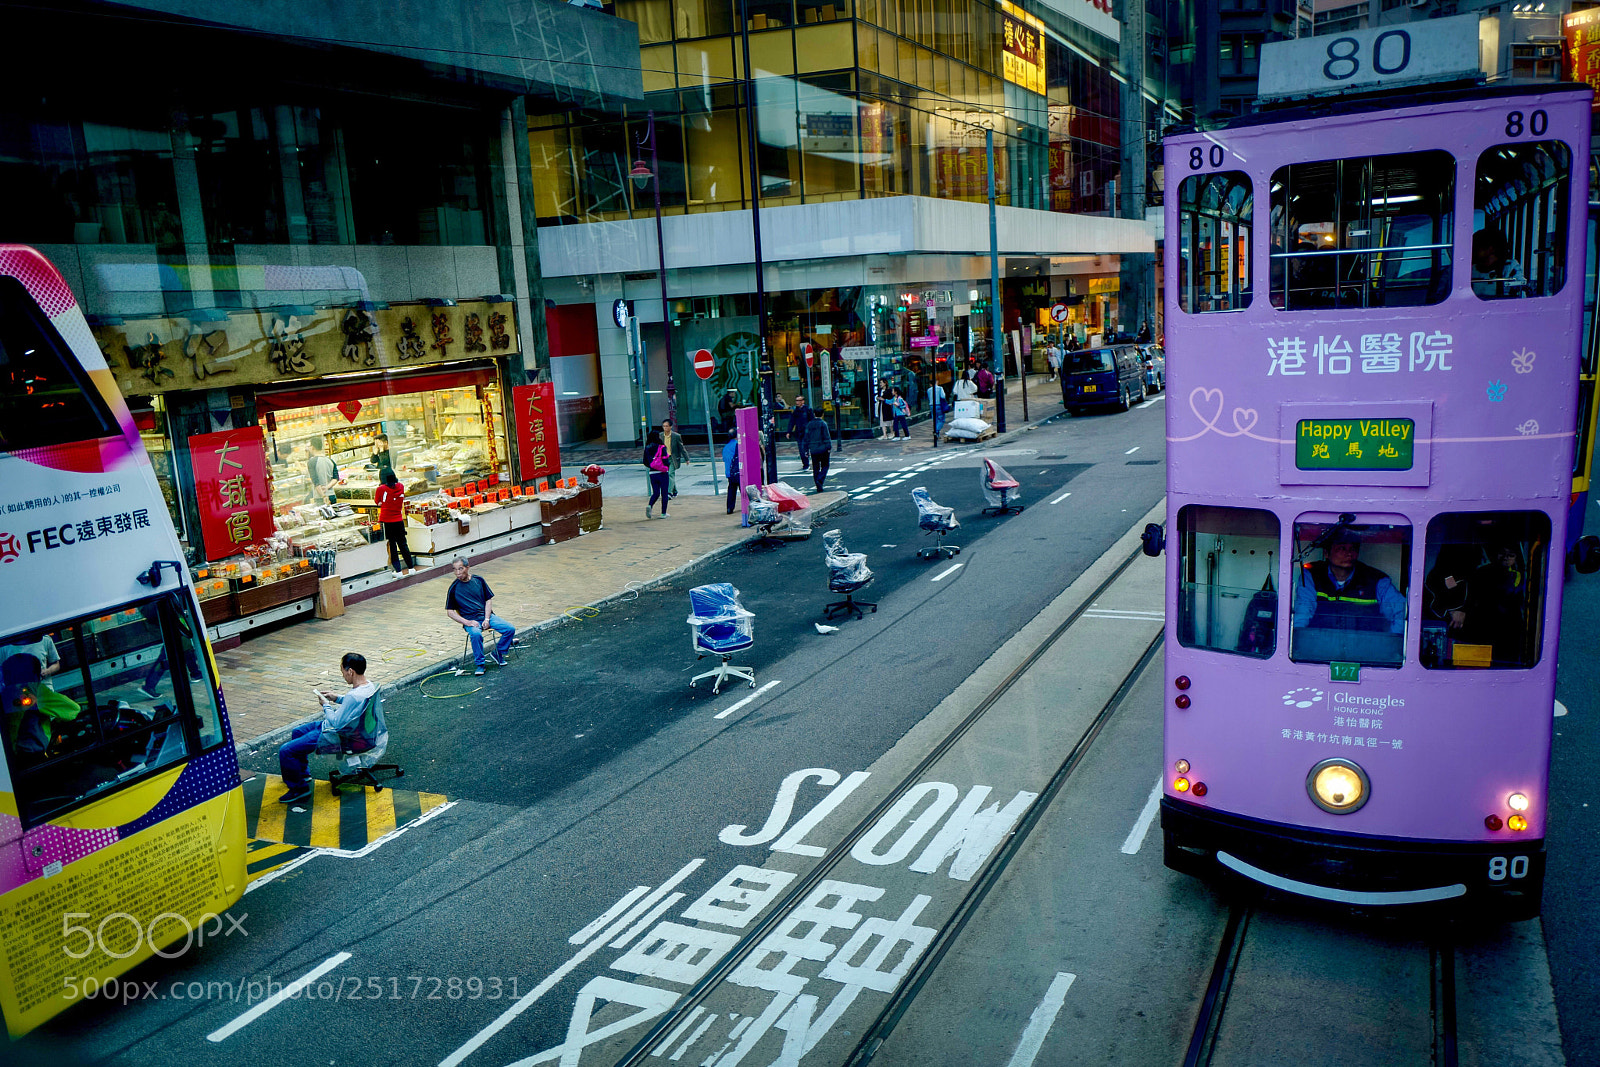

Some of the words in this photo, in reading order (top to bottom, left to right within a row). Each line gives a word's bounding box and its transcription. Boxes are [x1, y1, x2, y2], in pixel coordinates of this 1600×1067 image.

[1323, 30, 1412, 81] 80
[1505, 109, 1549, 138] 80
[1189, 145, 1225, 171] 80
[1266, 330, 1454, 377] 港怡醫院
[527, 391, 548, 471] 大清貨
[1301, 421, 1352, 440] Happy
[1360, 420, 1411, 440] Valley
[1312, 442, 1399, 459] 跑馬地
[214, 440, 254, 545] 大減價
[1334, 666, 1356, 678] 127
[1333, 706, 1359, 714] HONG
[1360, 708, 1384, 716] KONG
[1334, 692, 1405, 709] Gleneagles
[1333, 716, 1384, 730] 港怡醫院
[718, 767, 1039, 882] SLOW
[1488, 855, 1529, 881] 80
